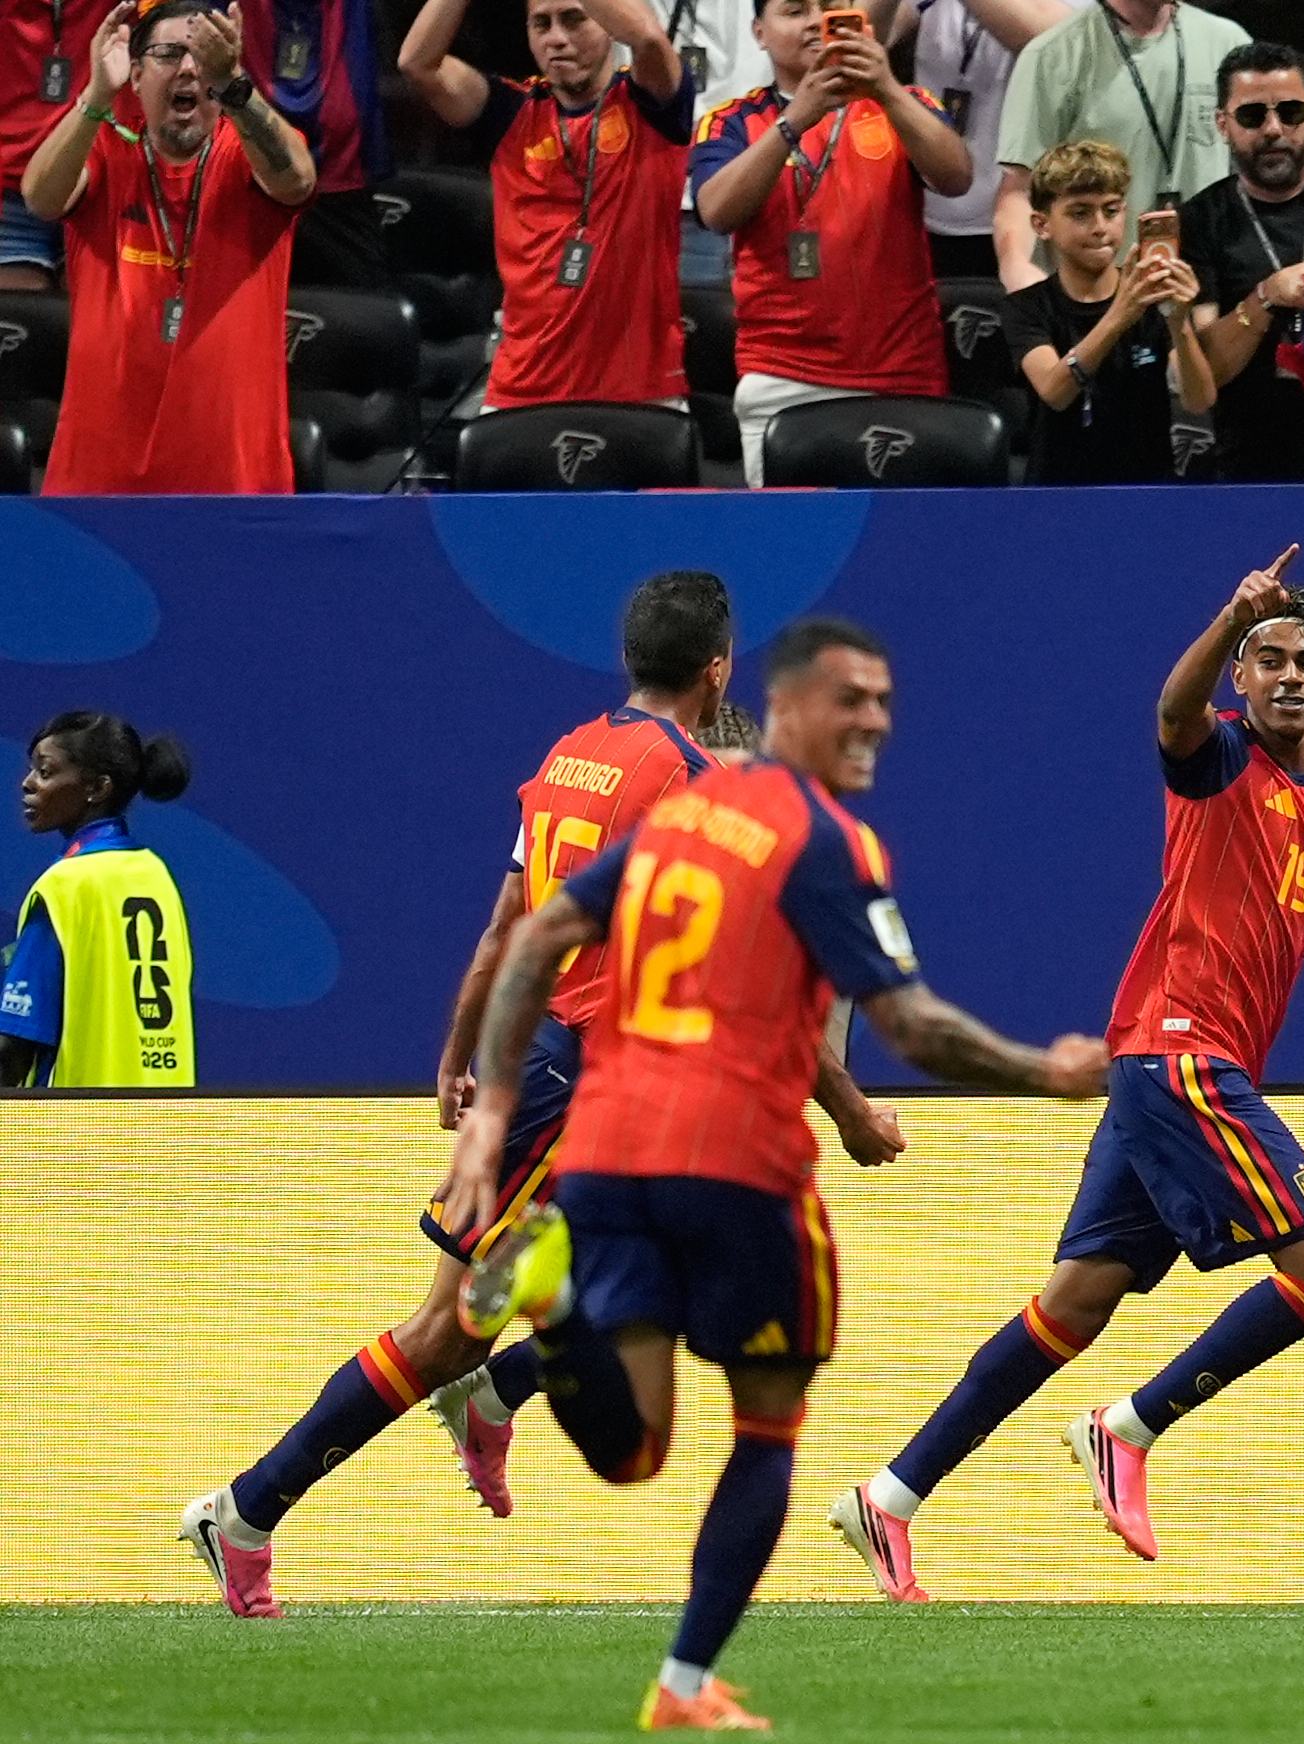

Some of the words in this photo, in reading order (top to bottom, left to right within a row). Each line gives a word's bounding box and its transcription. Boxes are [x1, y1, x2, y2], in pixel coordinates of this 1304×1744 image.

[544, 755, 623, 797] RODRIGO
[619, 851, 724, 1044] 12
[157, 1036, 175, 1048] CUP
